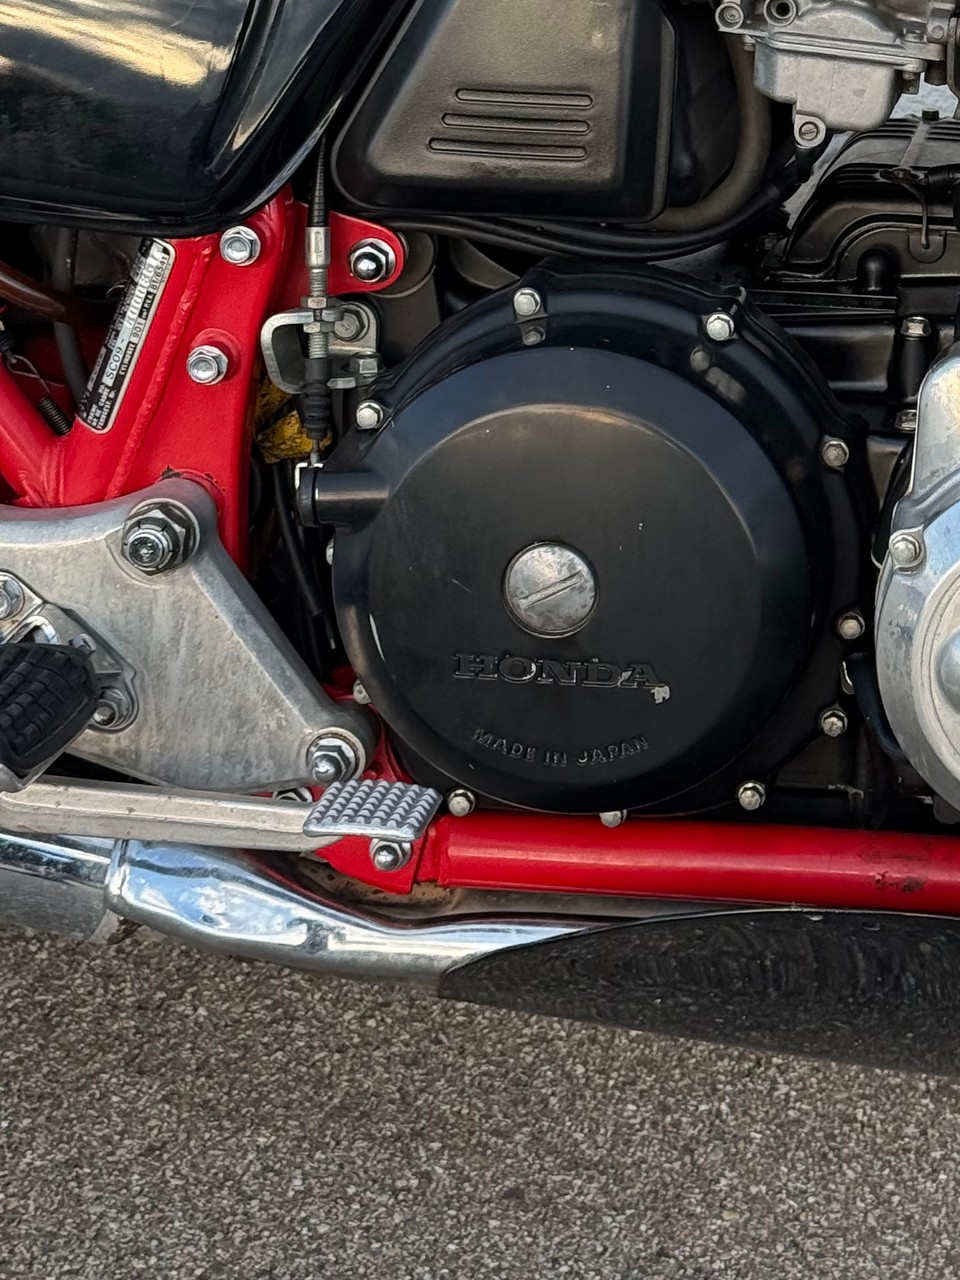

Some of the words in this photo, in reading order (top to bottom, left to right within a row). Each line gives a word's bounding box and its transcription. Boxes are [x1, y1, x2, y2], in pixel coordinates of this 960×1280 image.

[452, 652, 667, 689] HONDA
[471, 727, 537, 761] MADE
[545, 751, 568, 767] IN
[576, 736, 649, 766] JAPAN
